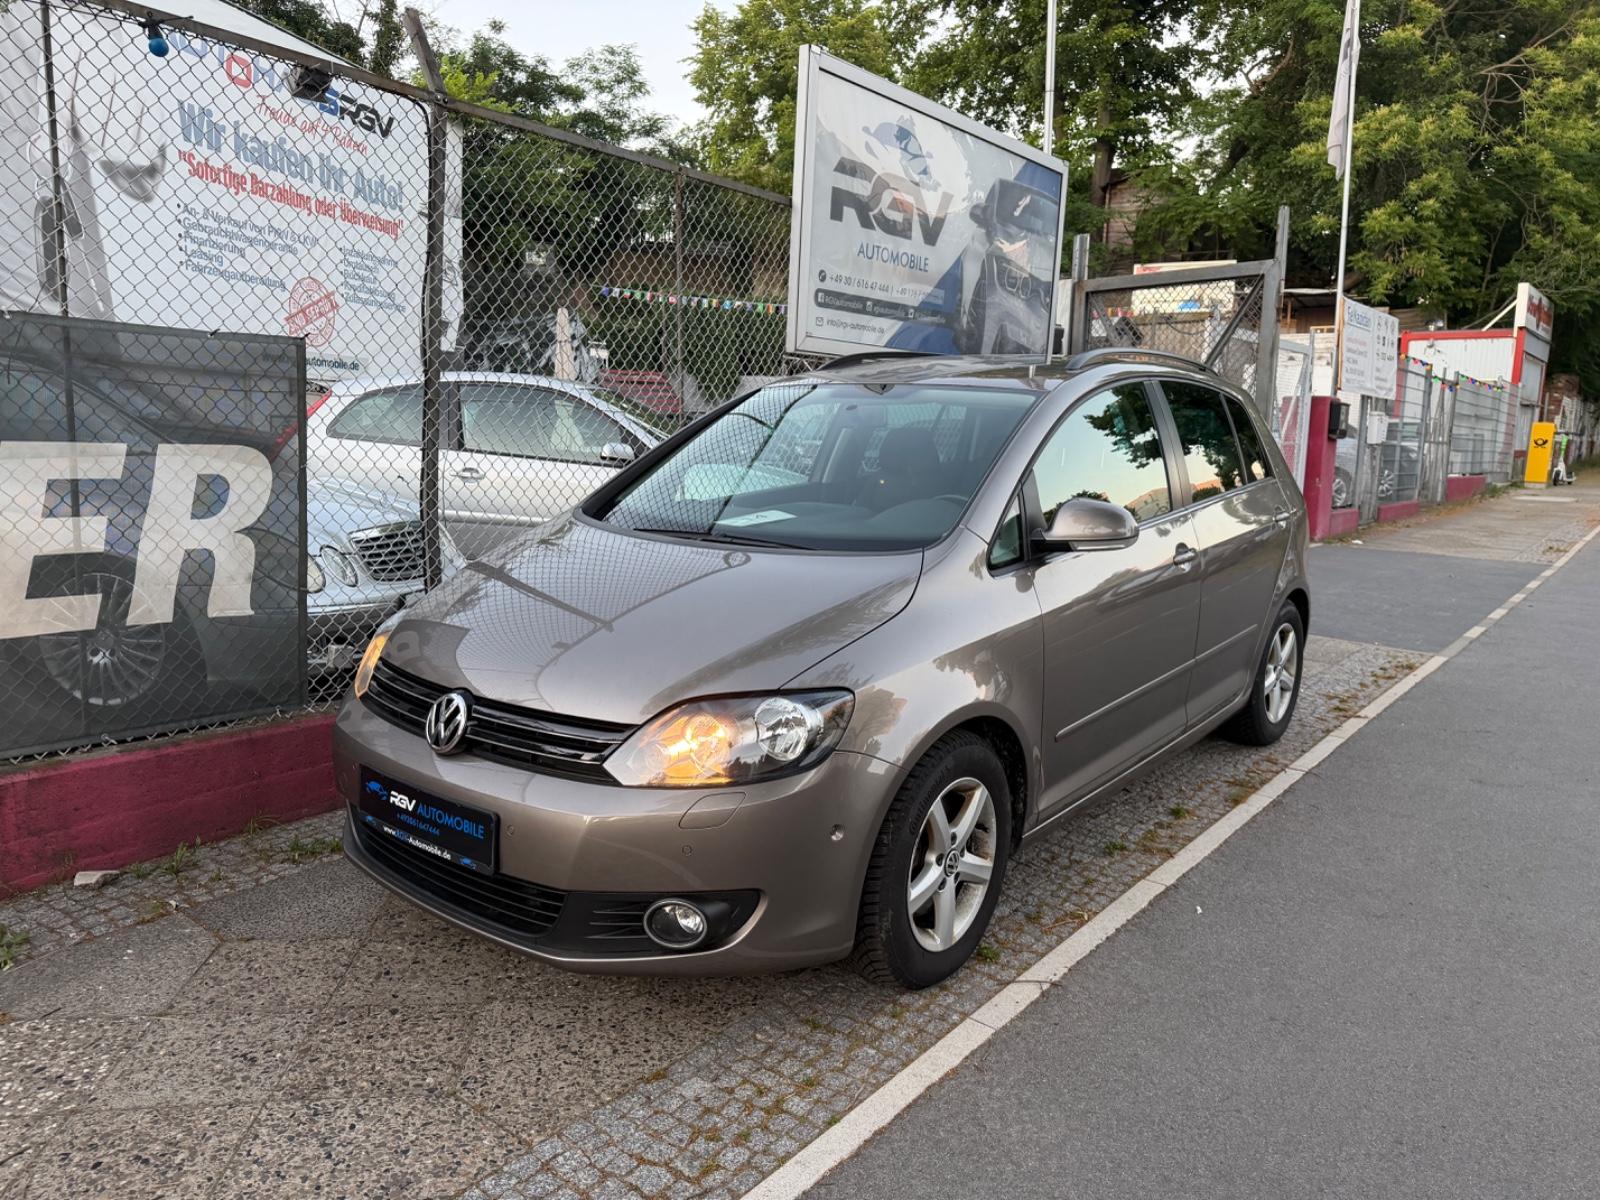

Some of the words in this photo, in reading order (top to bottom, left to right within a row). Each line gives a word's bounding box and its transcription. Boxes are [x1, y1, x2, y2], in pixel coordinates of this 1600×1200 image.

[339, 93, 394, 138] RGV
[177, 100, 226, 152] Wir
[233, 120, 313, 184] kaufen
[319, 152, 348, 193] Ihr
[354, 168, 403, 210] Auto!
[251, 172, 312, 216] Barzahlung
[315, 196, 336, 219] oder
[830, 157, 954, 247] RGV
[184, 245, 224, 267] Leasing
[857, 242, 929, 273] AUTOMOBILE
[389, 790, 417, 812] RGV
[417, 803, 485, 839] AUTOMOBILE
